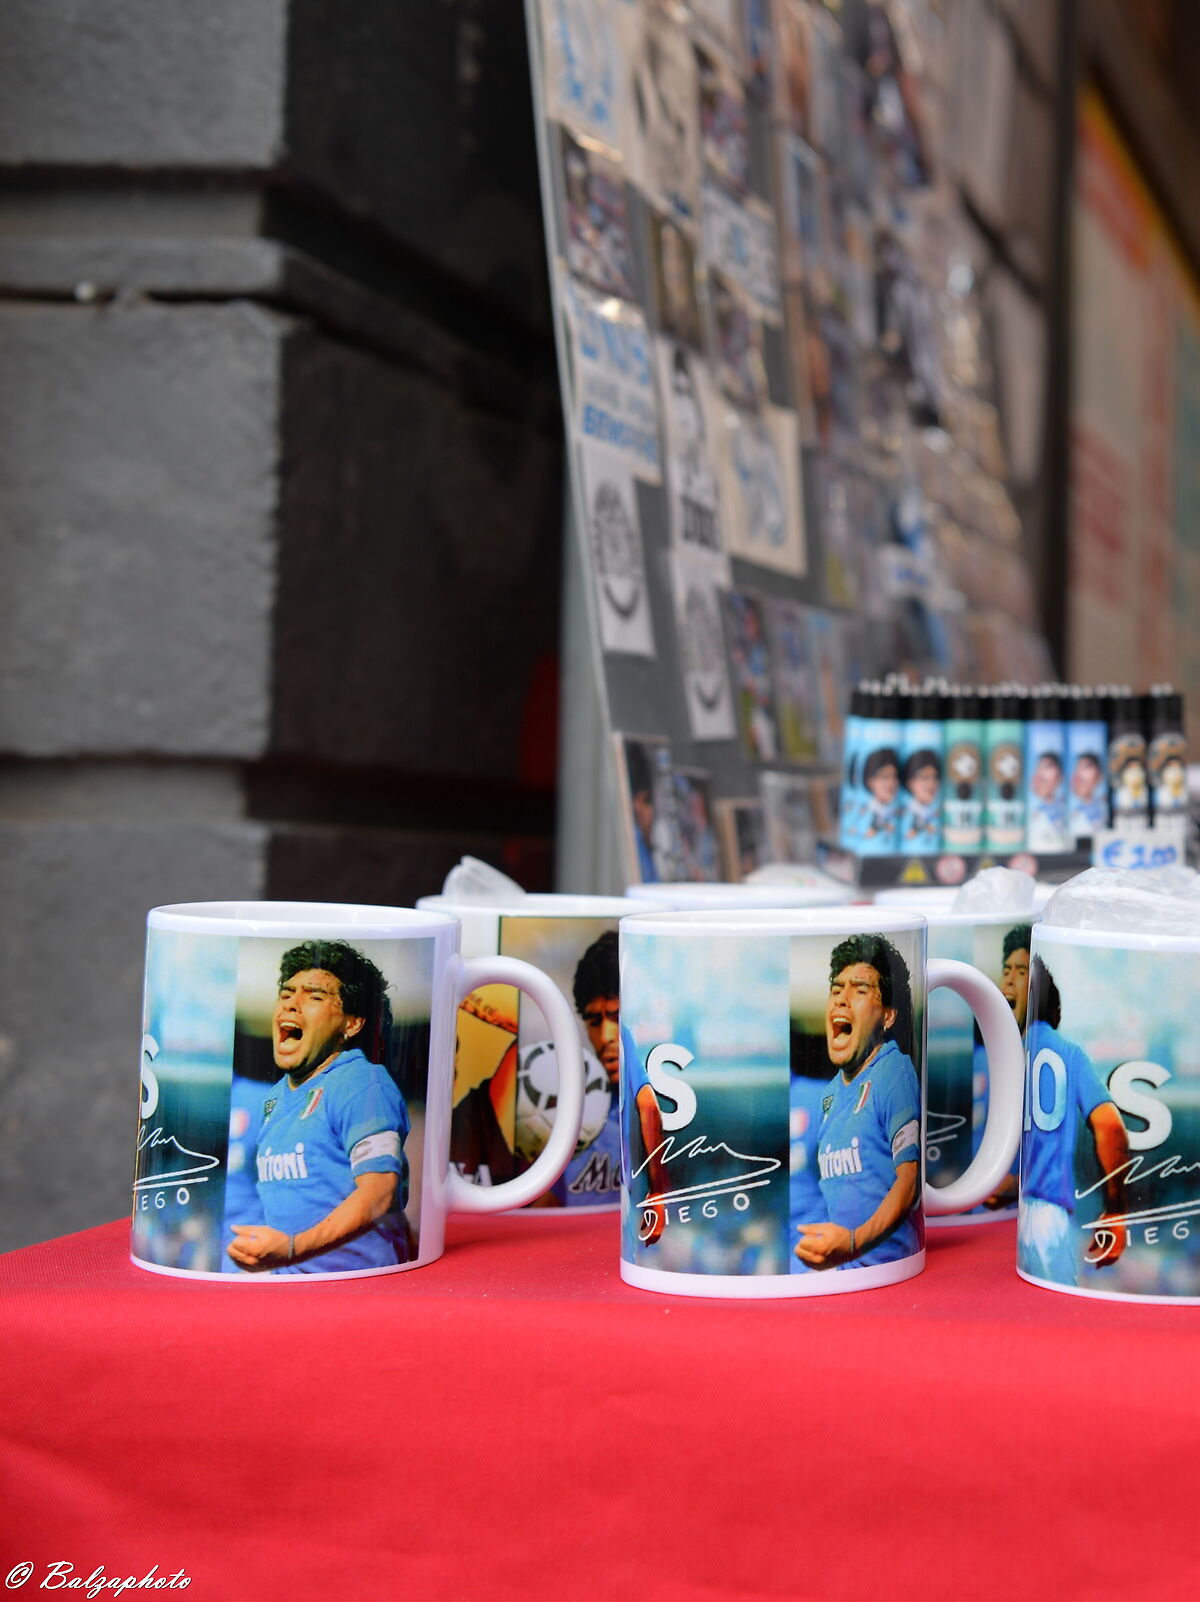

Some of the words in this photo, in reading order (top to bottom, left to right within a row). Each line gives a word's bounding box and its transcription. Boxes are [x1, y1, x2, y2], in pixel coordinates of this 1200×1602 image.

[646, 1043, 697, 1131] S
[1107, 1060, 1173, 1150] S
[638, 1192, 750, 1241] DIEGO
